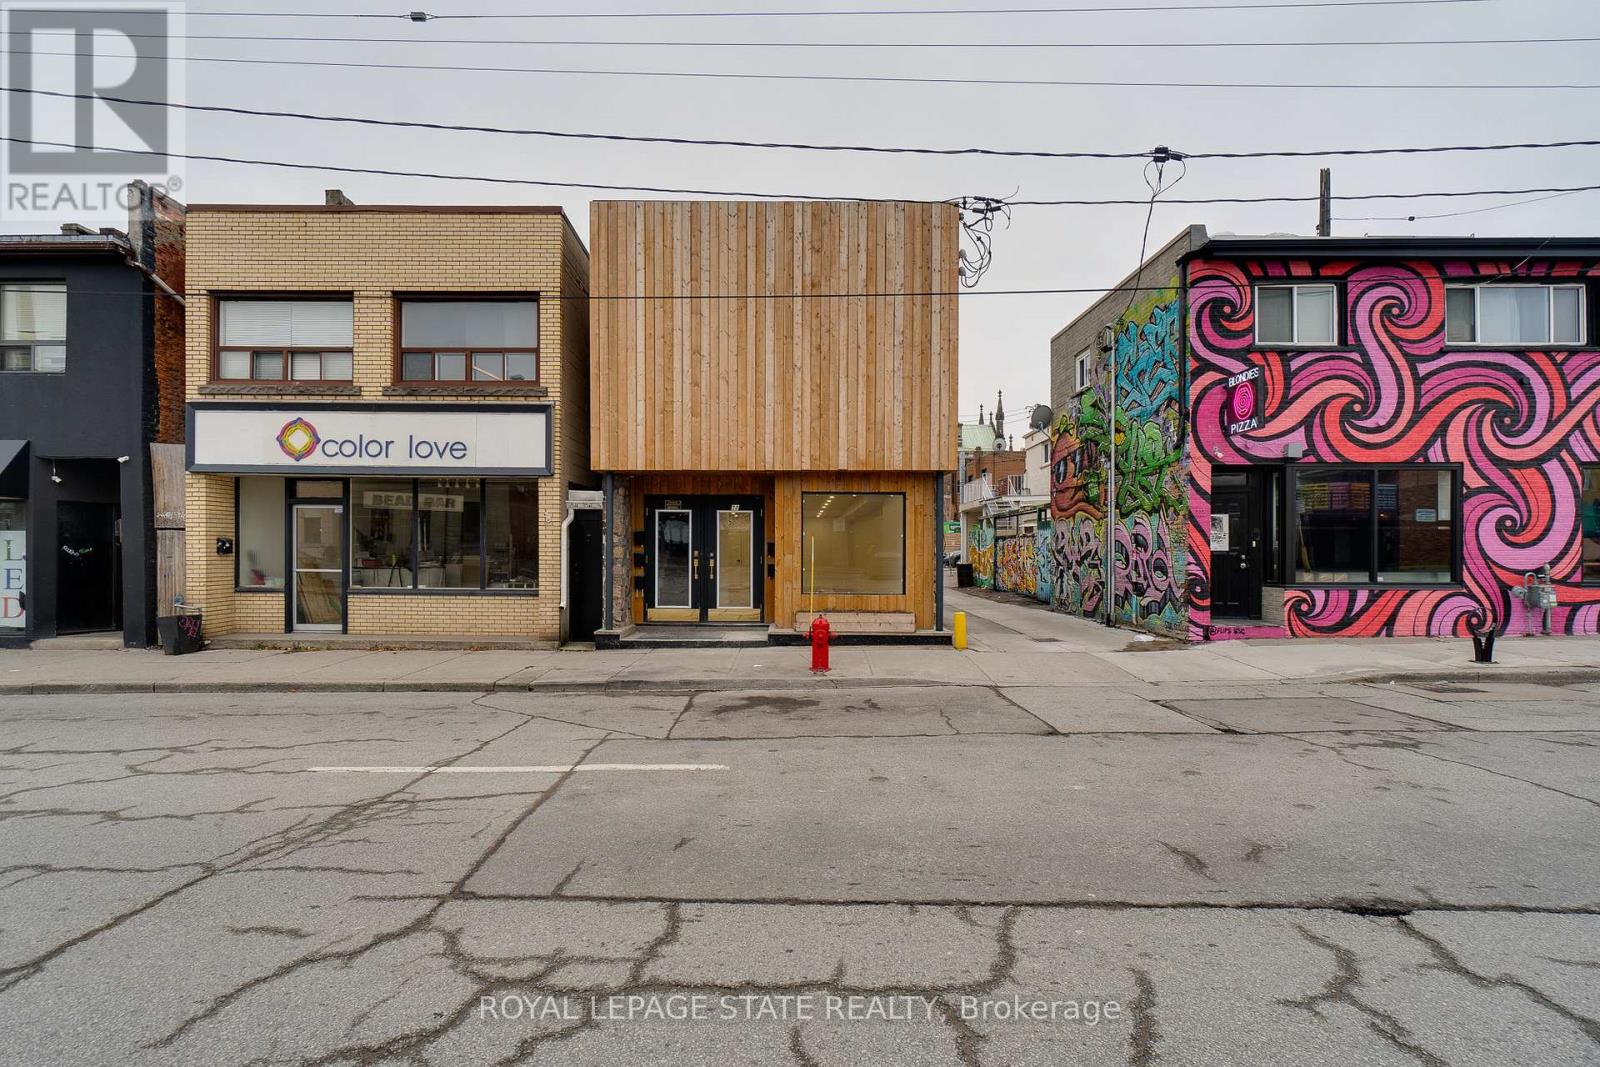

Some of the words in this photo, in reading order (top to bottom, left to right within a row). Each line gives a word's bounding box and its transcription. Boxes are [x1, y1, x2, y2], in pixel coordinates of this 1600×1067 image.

[1228, 367, 1259, 388] BLONDIES
[1230, 418, 1258, 434] PIZZA
[321, 434, 395, 459] color
[408, 434, 468, 460] love
